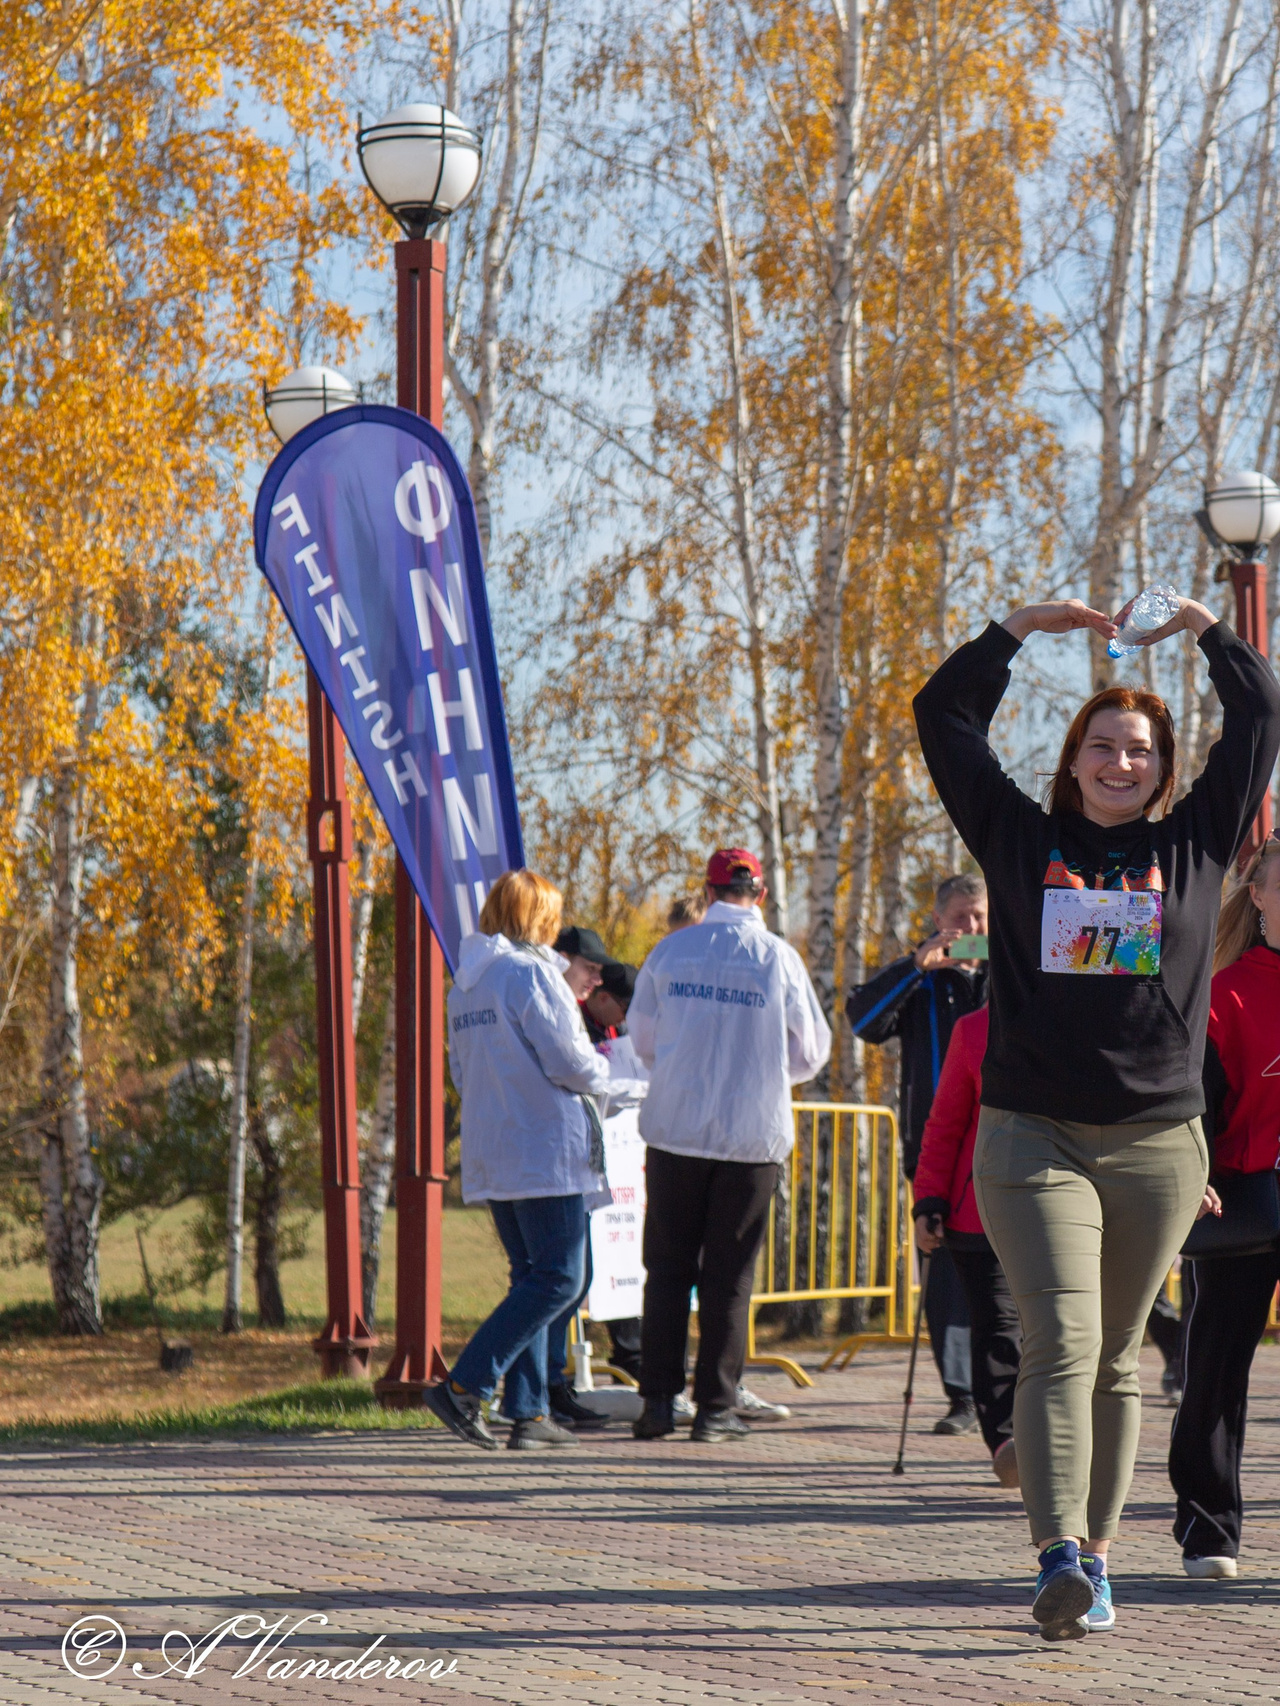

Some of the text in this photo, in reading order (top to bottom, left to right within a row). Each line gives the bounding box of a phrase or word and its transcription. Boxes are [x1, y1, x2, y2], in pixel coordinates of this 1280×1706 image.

[1082, 926, 1121, 966] 77
[668, 982, 766, 1009] ОМСКАЯ ОБЛАСТЬ
